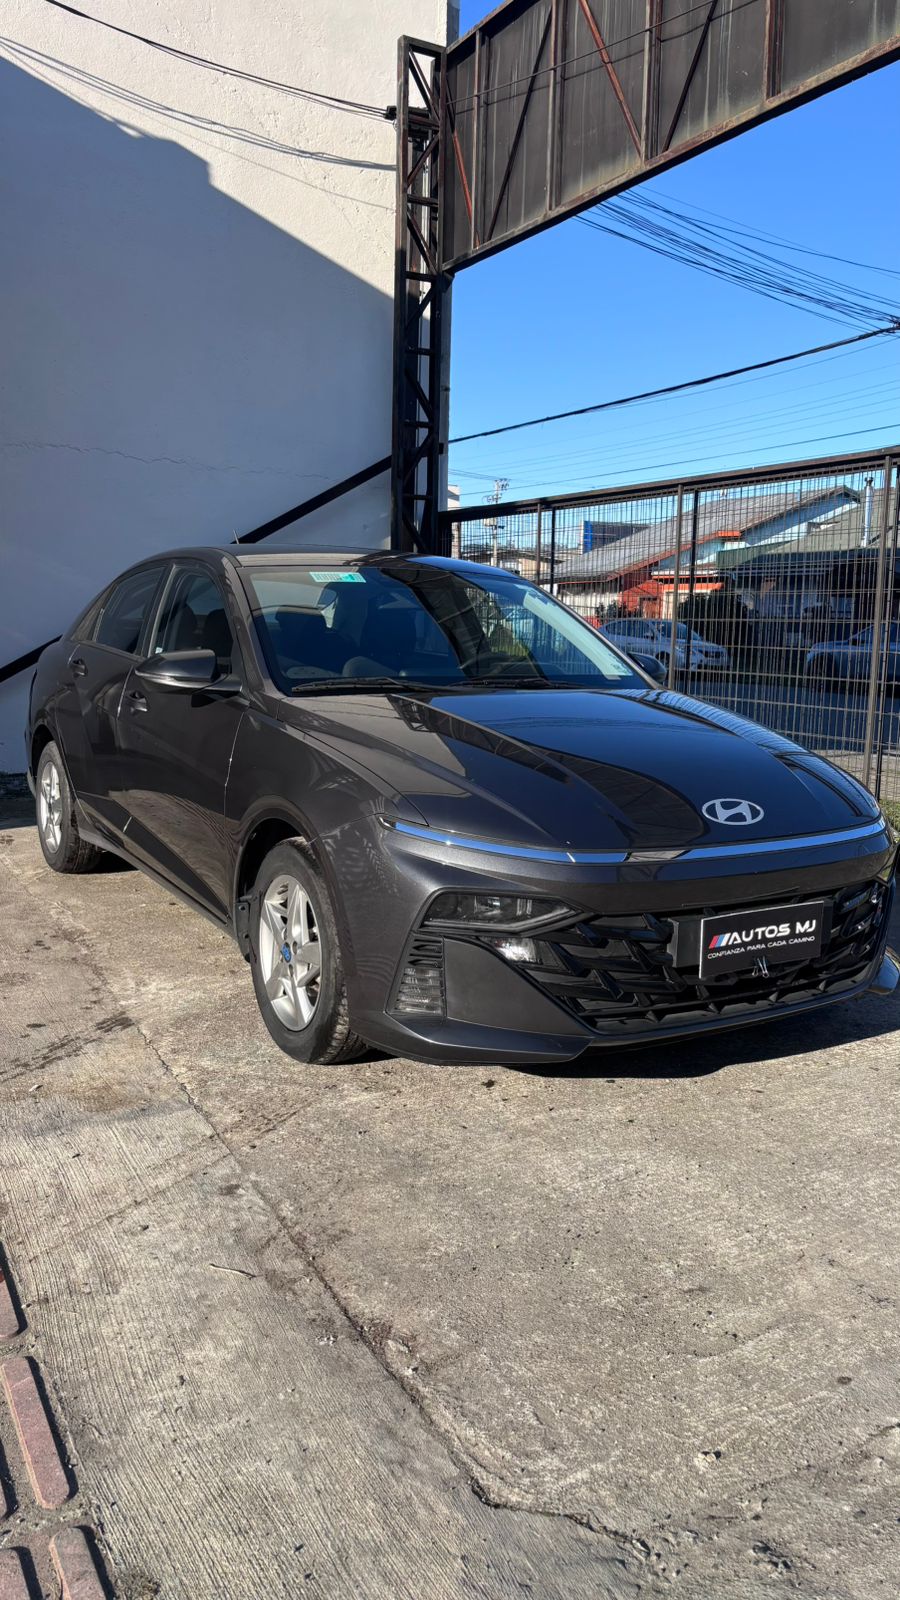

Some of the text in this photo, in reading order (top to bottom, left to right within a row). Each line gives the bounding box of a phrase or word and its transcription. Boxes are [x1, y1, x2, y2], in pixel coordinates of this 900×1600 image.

[728, 919, 817, 945] AUTOS MJ
[707, 936, 815, 959] CONFIANZA PARA CADA CAMINO
